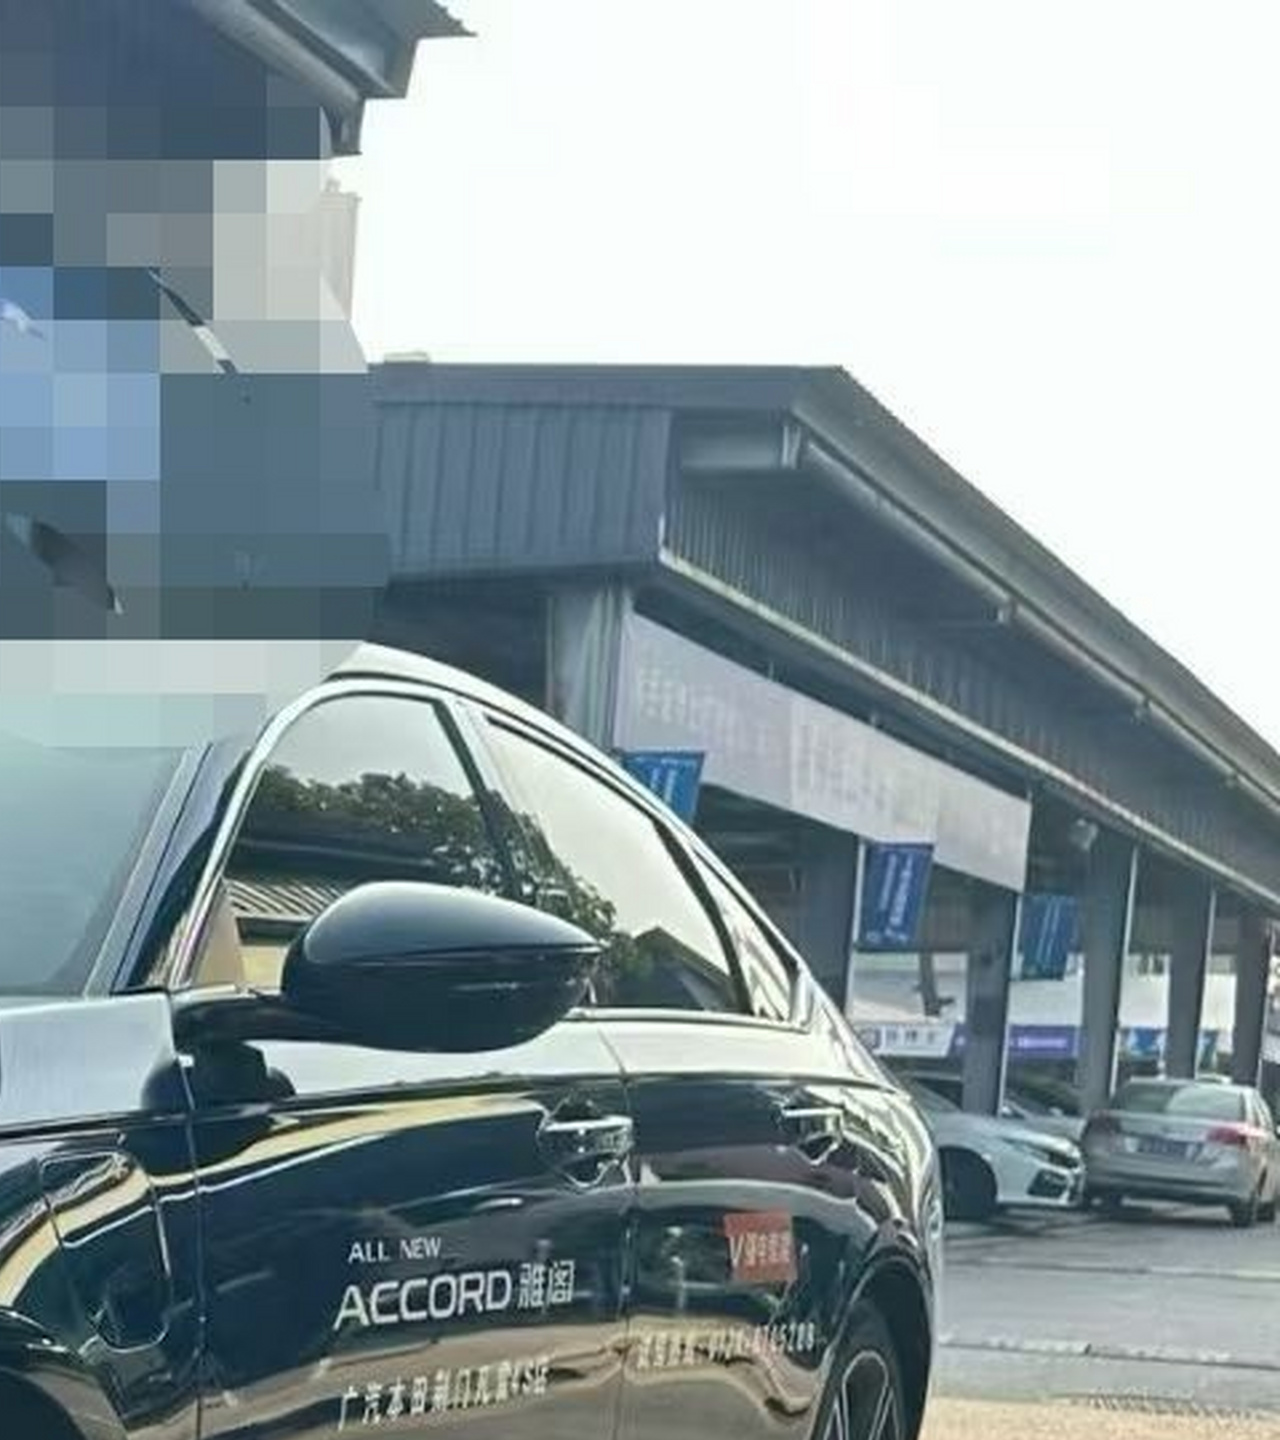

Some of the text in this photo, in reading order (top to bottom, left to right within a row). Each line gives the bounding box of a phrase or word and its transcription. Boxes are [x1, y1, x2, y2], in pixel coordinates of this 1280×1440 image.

[347, 1236, 442, 1264] ALL NEW
[332, 1258, 576, 1331] ACCORD 雅阁
